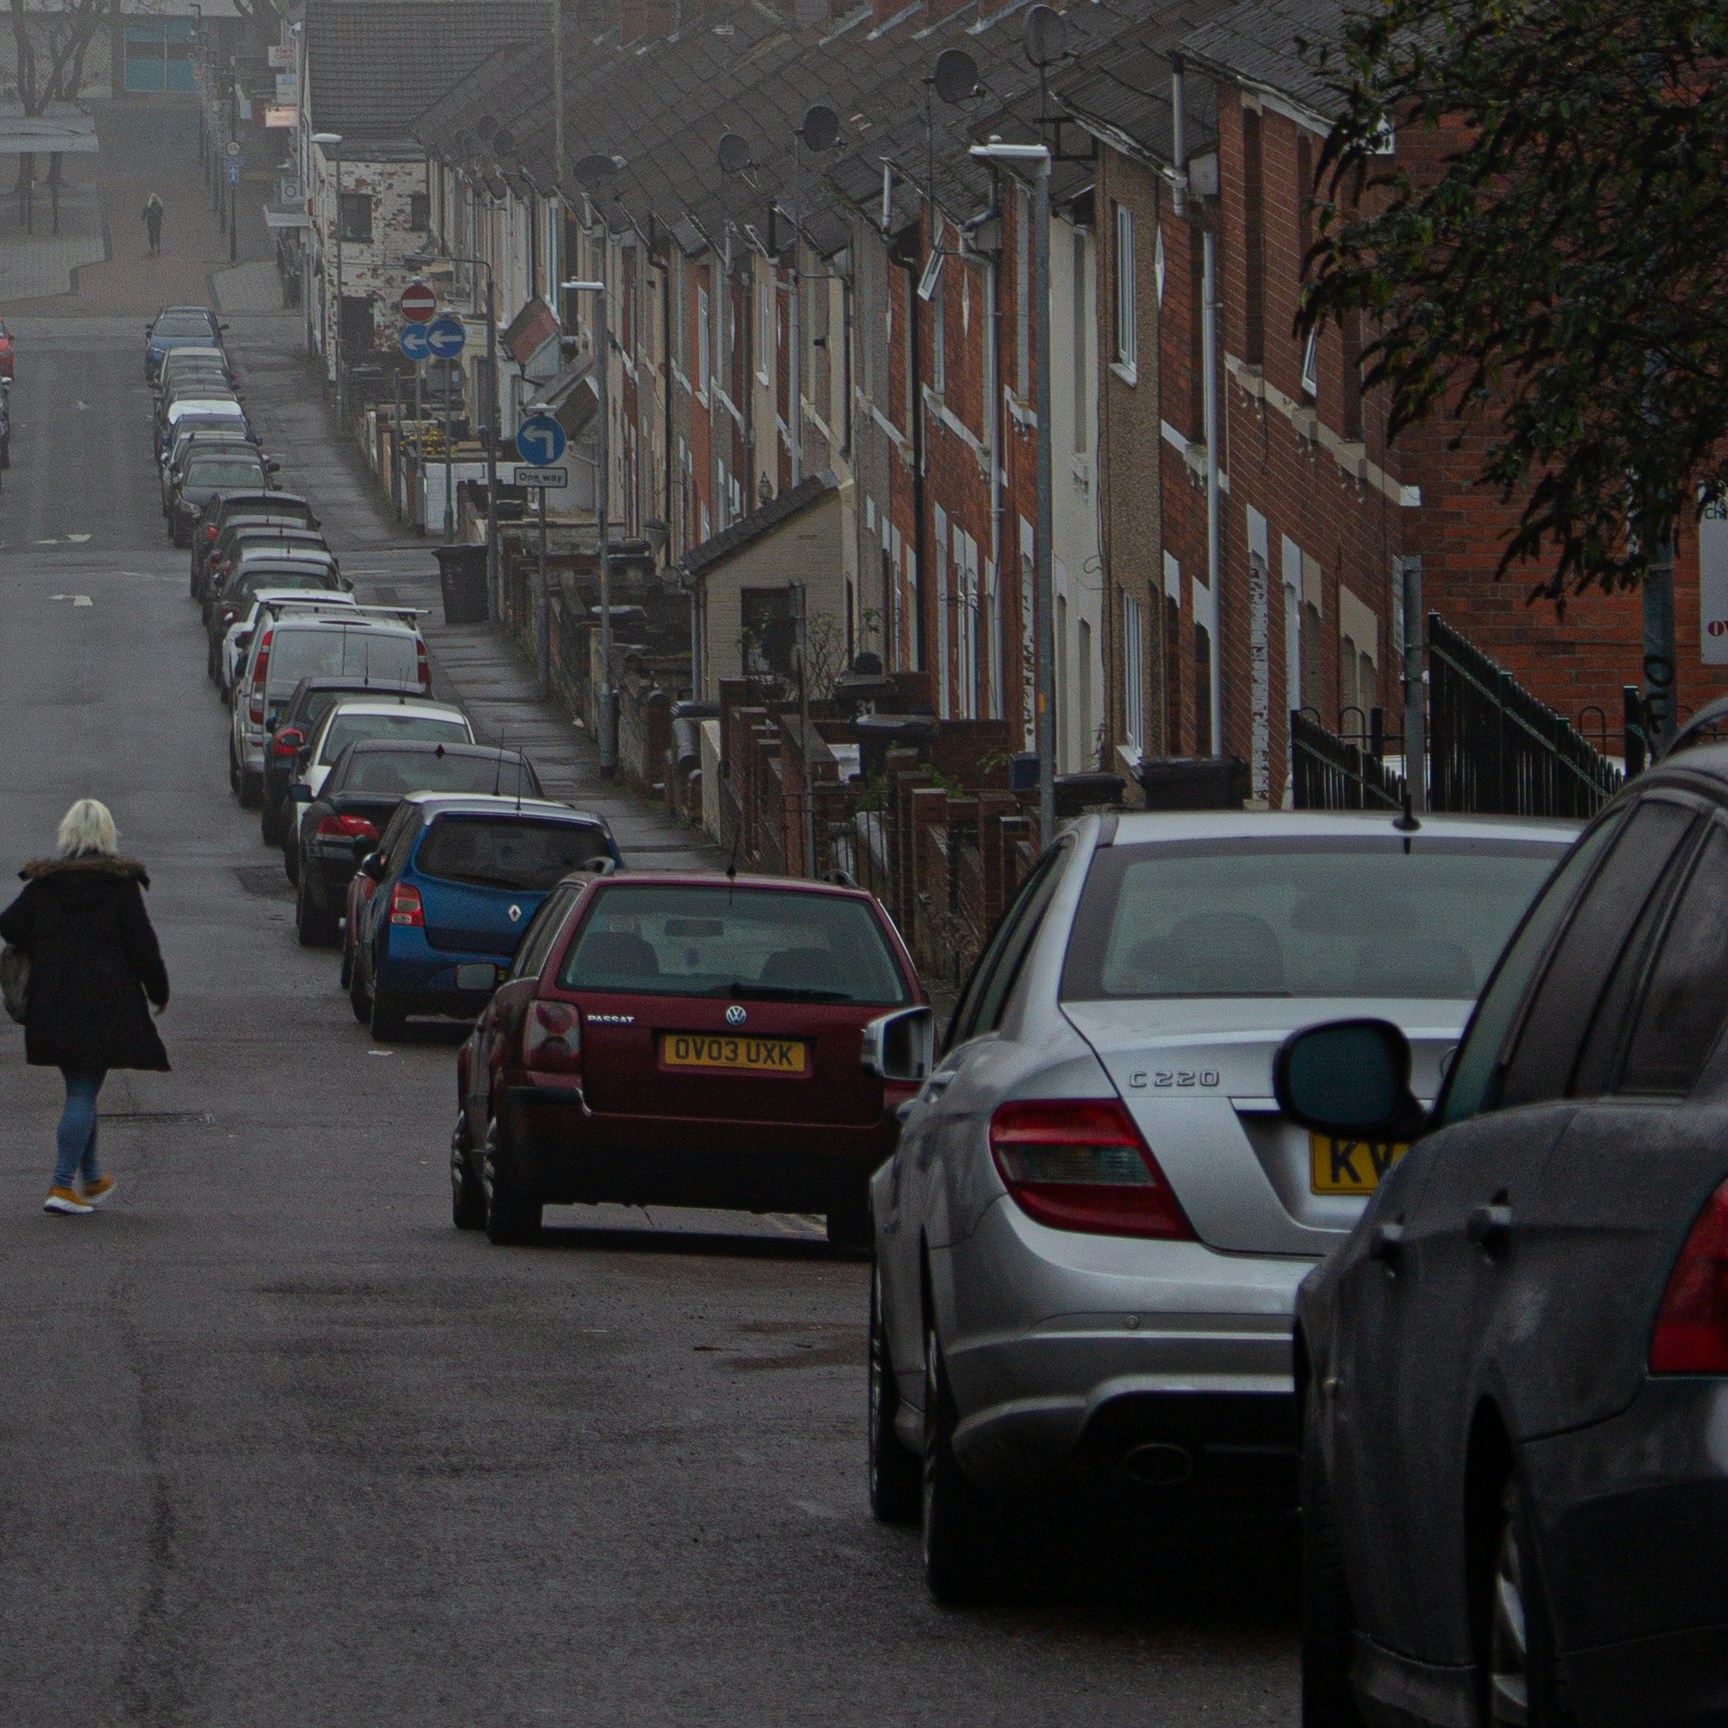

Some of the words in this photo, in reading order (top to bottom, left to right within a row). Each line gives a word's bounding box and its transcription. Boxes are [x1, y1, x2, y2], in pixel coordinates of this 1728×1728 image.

[519, 472, 539, 482] One
[542, 474, 562, 484] way
[587, 1014, 635, 1024] PASSAT
[674, 1038, 739, 1062] OV03
[746, 1041, 794, 1067] UXK
[1129, 1071, 1147, 1088] C
[1154, 1070, 1220, 1088] 220
